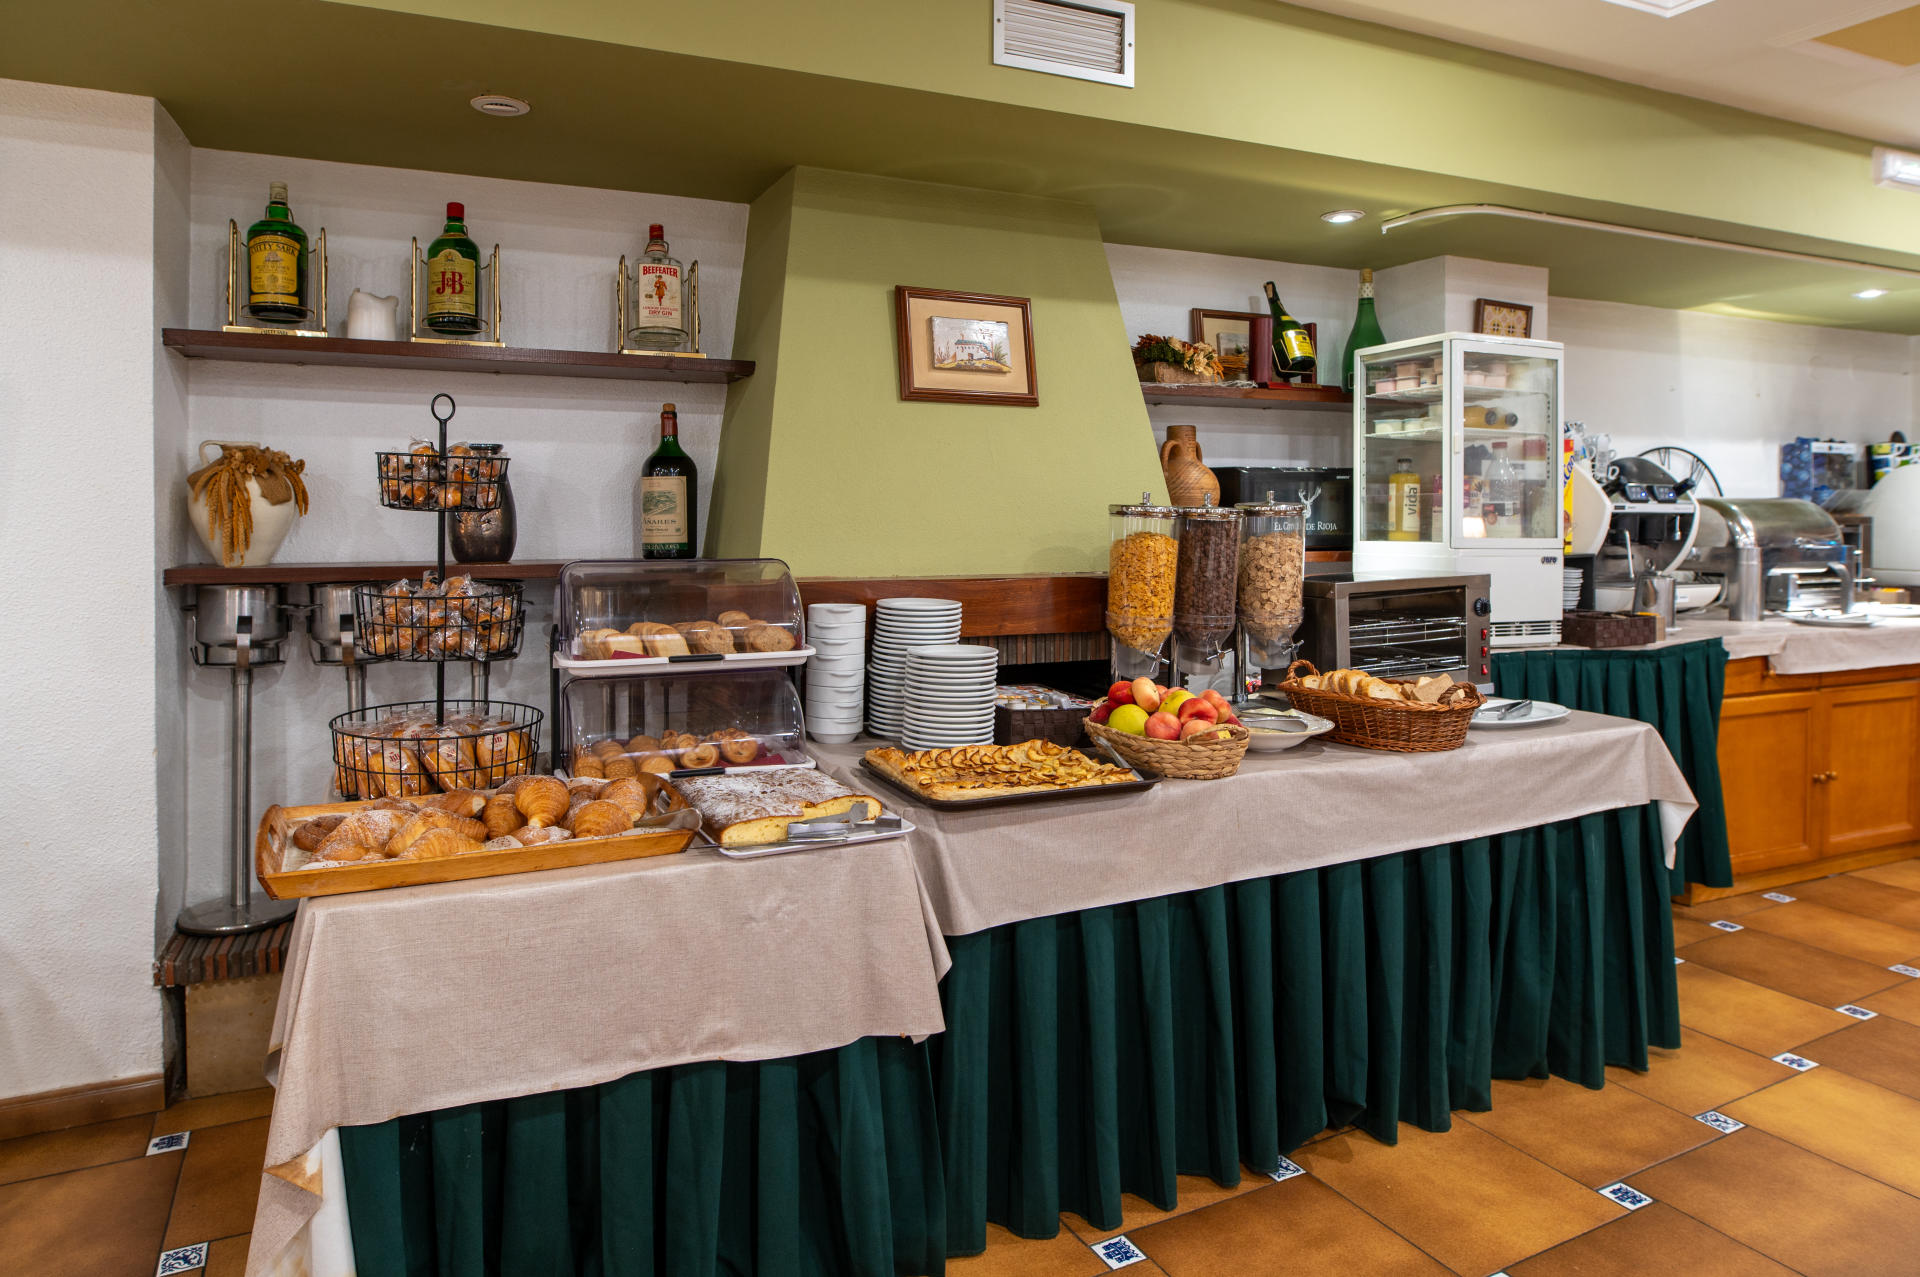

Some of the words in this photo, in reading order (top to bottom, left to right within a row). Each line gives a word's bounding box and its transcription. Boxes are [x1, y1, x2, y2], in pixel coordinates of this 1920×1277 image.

[276, 244, 296, 256] SARK
[642, 266, 678, 278] BEEFEATER
[436, 271, 464, 295] J&B
[1405, 487, 1418, 515] vida
[1305, 523, 1316, 531] DE
[1317, 521, 1337, 532] RIOJA
